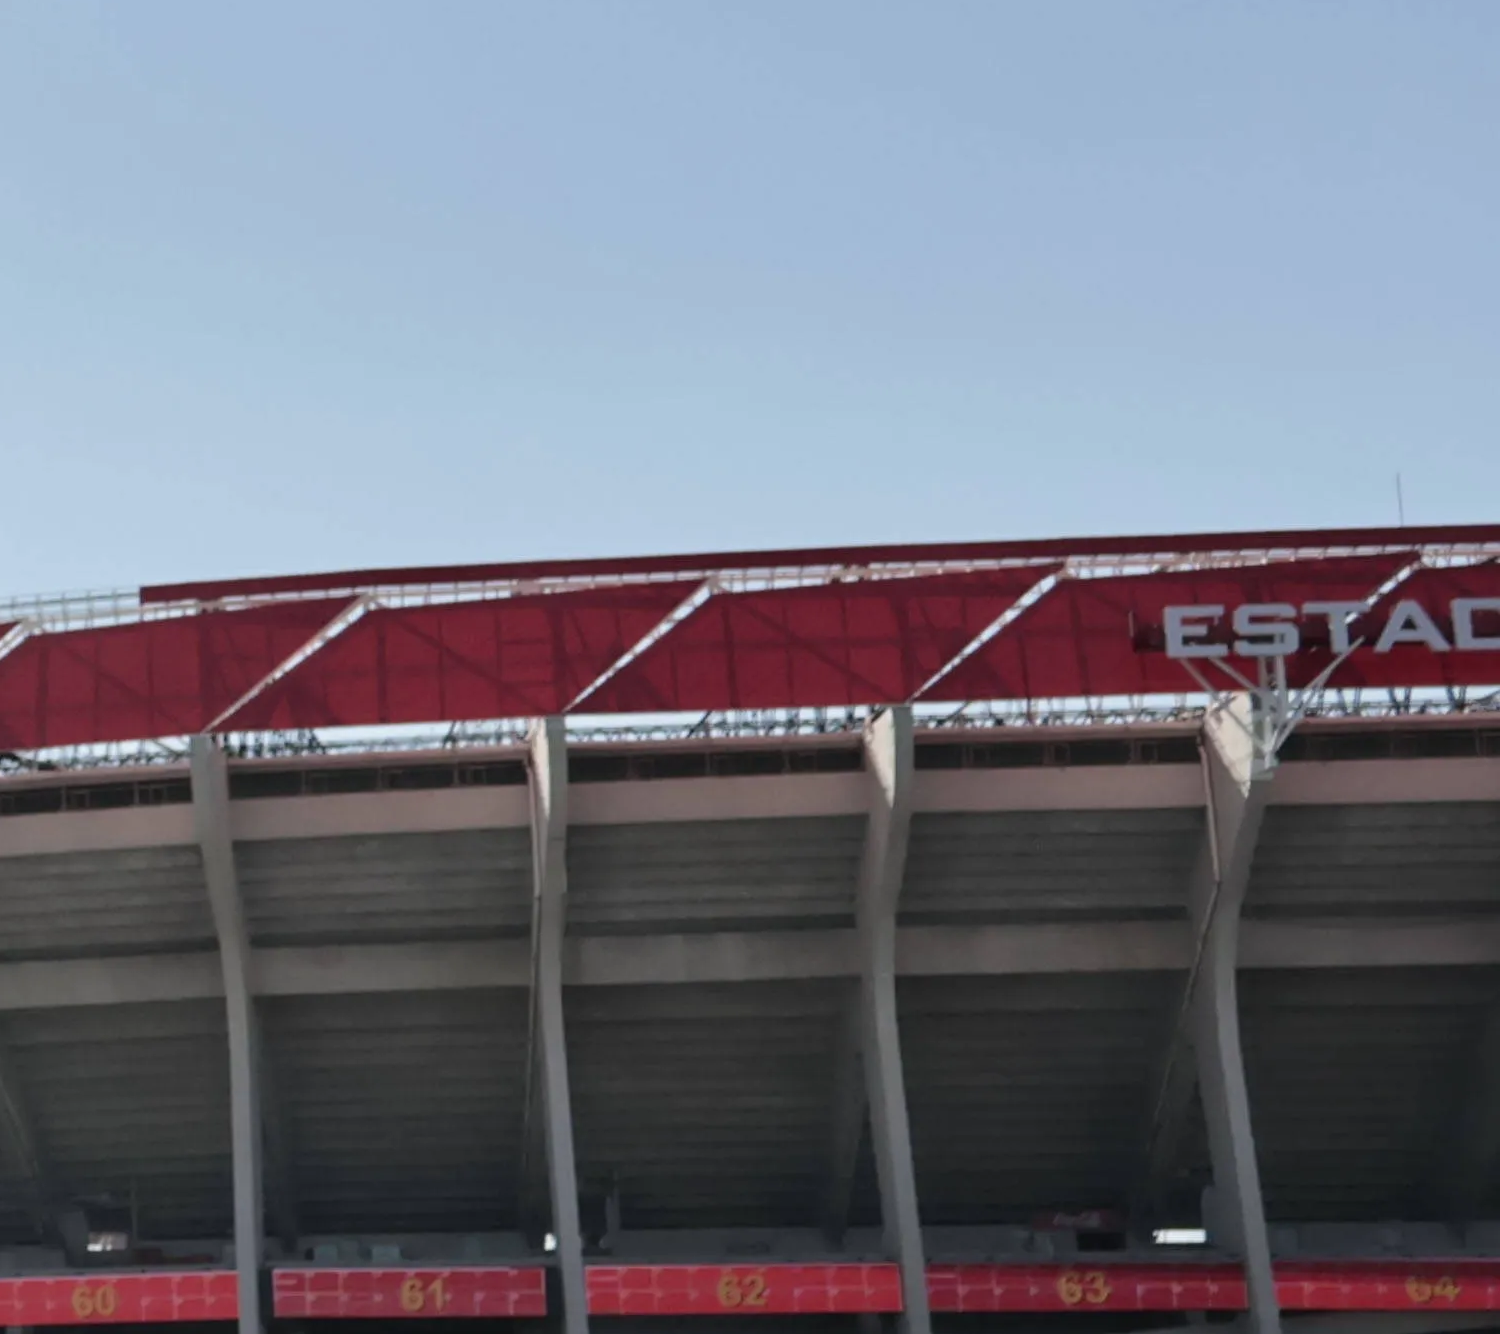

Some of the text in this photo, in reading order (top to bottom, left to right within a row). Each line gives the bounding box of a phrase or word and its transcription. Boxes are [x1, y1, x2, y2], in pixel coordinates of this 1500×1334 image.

[71, 1283, 119, 1317] 60
[400, 1279, 447, 1312] 61
[716, 1275, 770, 1308] 62
[1057, 1270, 1112, 1305] 63
